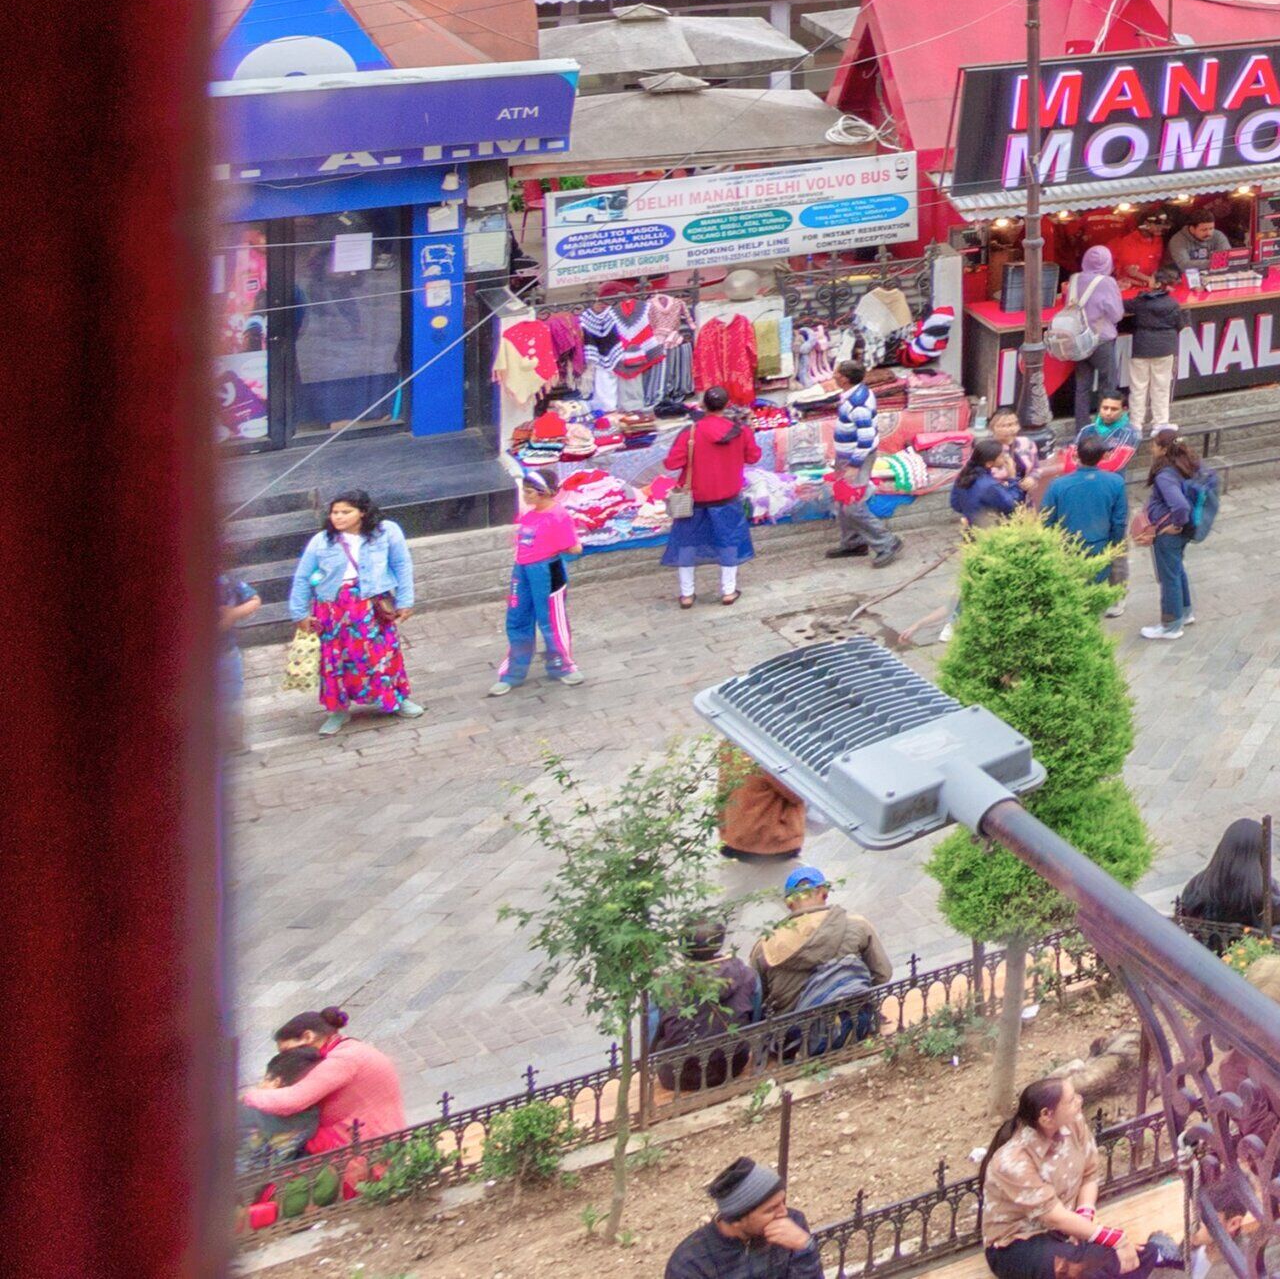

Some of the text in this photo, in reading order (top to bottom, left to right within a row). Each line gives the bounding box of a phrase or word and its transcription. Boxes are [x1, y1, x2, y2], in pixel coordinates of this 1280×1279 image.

[496, 106, 540, 122] ATM
[636, 194, 683, 212] DELHI
[689, 186, 749, 205] MANALI
[755, 182, 800, 198] DELHI
[806, 173, 855, 191] VOLVO
[861, 169, 891, 185] BUS
[569, 226, 664, 242] MANALI TO KASOL,
[633, 232, 669, 241] KULLU,
[803, 222, 911, 241] FOR INSTANT RESERVATION
[577, 246, 607, 256] BACK
[609, 244, 623, 252] TO
[624, 239, 664, 249] MANALI
[687, 245, 735, 258] BOOKING
[738, 240, 765, 251] HELP
[766, 237, 790, 247] LINE
[816, 232, 898, 249] CONTACT RECEPTION
[556, 253, 670, 277] SPECIAL OFFER FOR GROUPS
